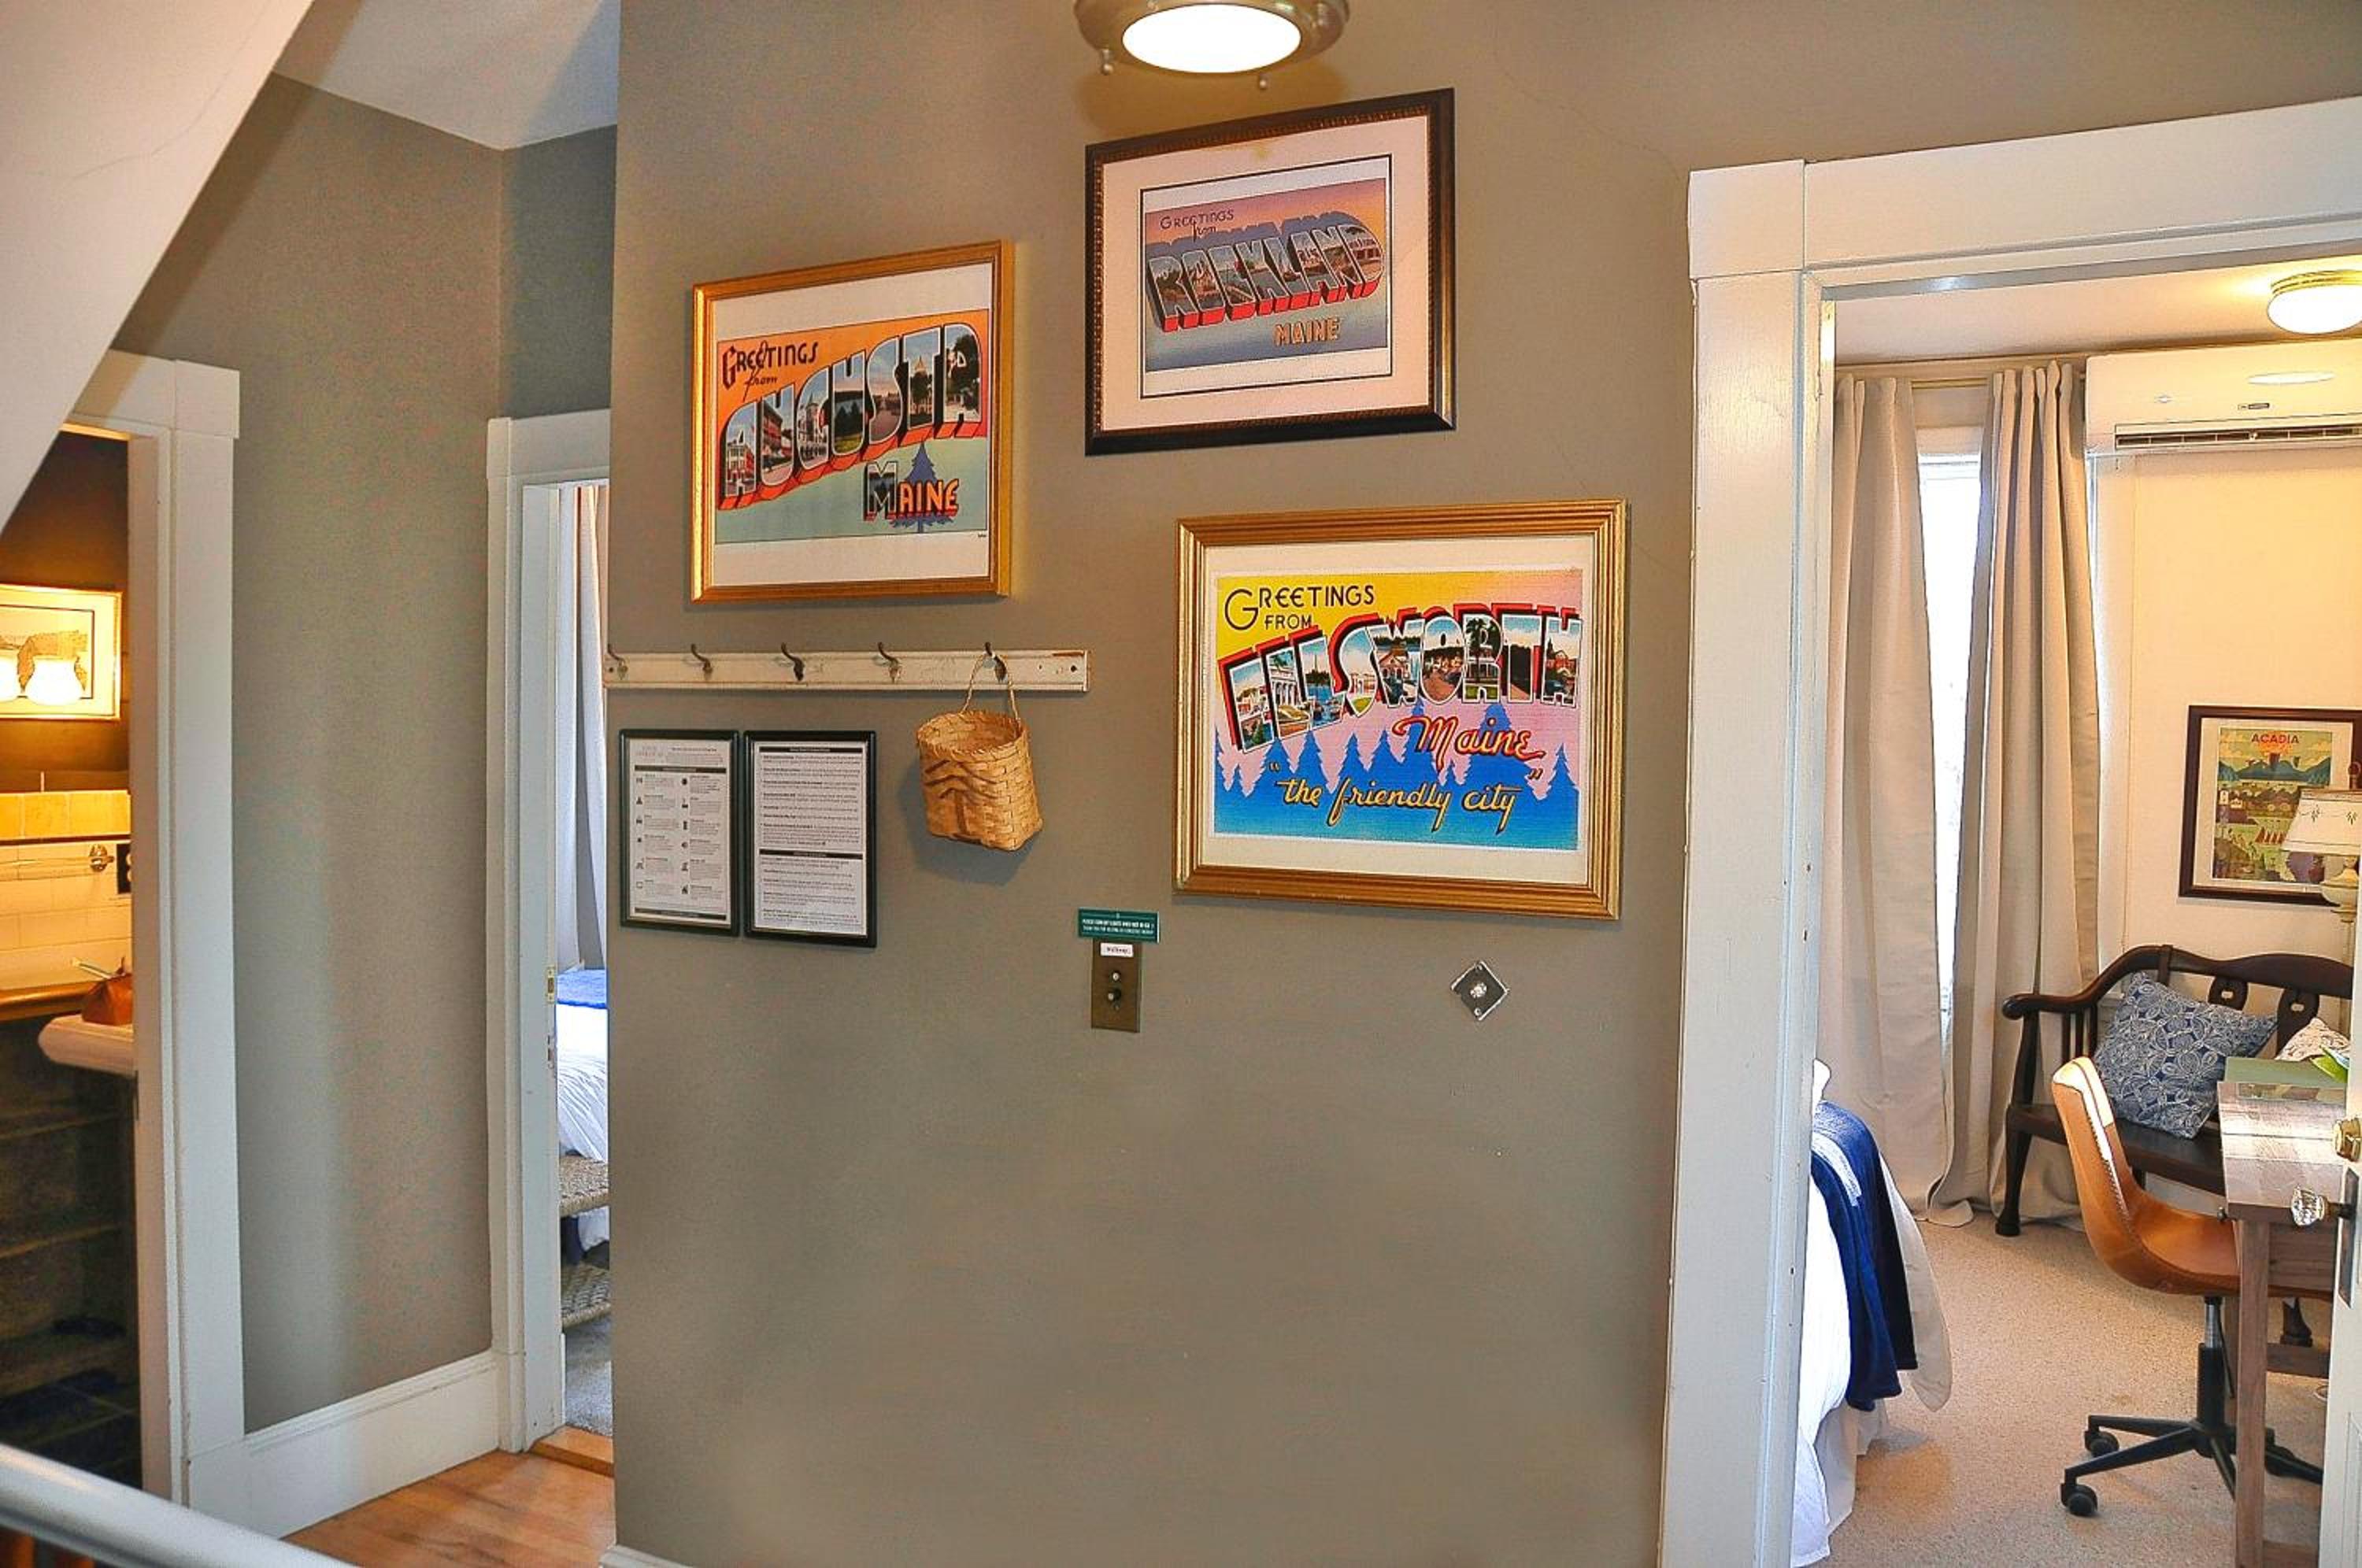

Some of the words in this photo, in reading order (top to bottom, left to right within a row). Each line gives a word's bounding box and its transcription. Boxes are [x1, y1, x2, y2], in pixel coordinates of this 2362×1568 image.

[1160, 209, 1234, 229] GREETINGS
[1146, 224, 1386, 332] ROCKLAND
[1273, 316, 1341, 346] MAINE
[722, 342, 819, 390] GREETINGS
[717, 323, 986, 511] AUGUSTA
[863, 460, 960, 521] MAINE
[1224, 585, 1375, 631] GREETINGS
[1264, 614, 1312, 631] FROM
[1218, 603, 1583, 753] ELLSWORTH
[1391, 715, 1546, 774] Maine
[2251, 733, 2300, 745] ACADIA
[1328, 778, 1453, 834] friendly
